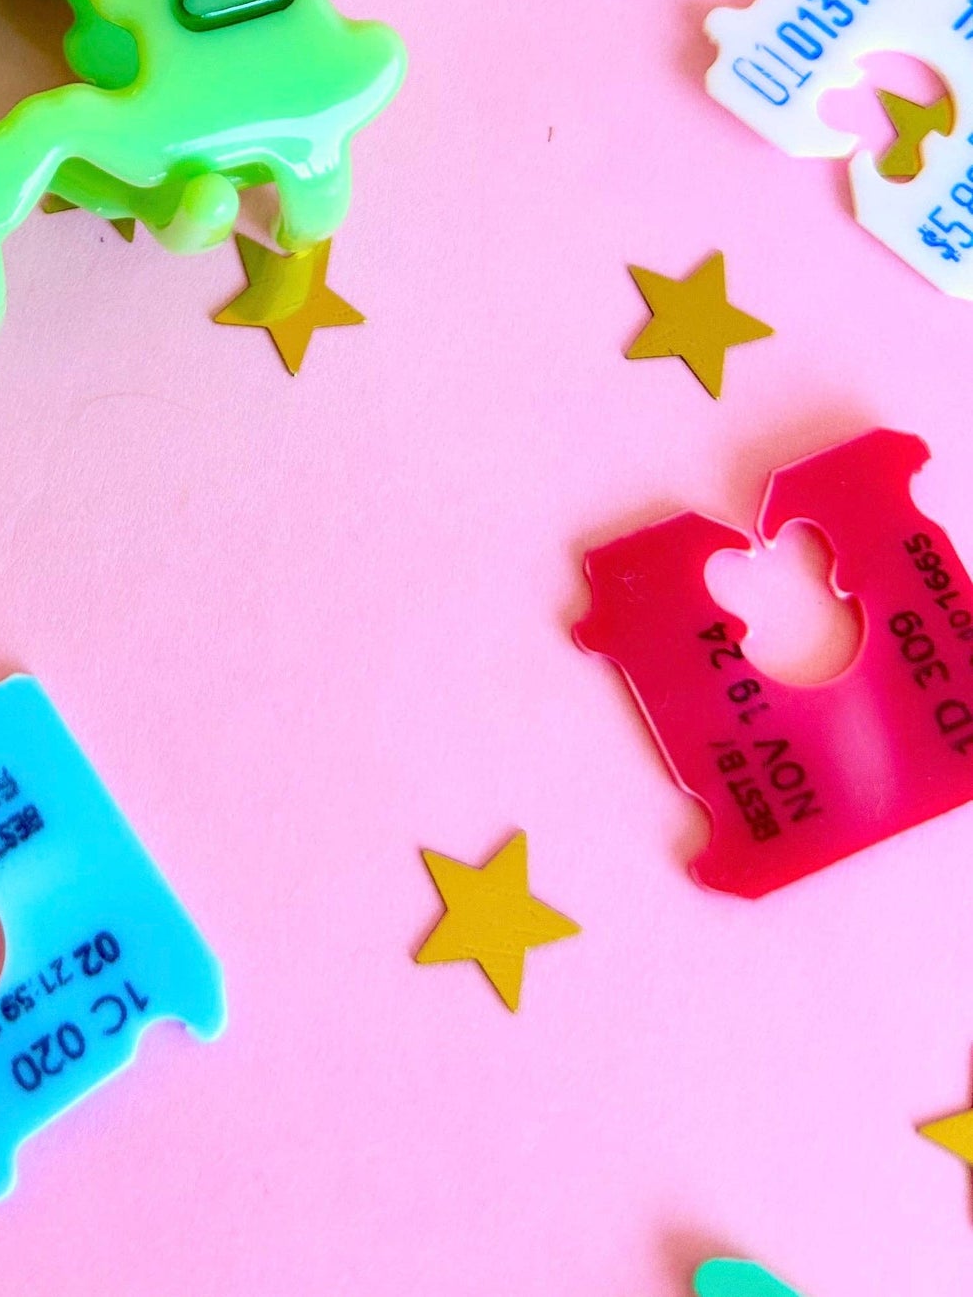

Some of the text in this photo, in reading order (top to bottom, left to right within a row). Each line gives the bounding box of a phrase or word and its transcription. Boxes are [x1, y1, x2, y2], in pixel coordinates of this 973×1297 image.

[888, 609, 951, 691] 309
[696, 620, 824, 824] NOV 19 24
[727, 776, 781, 842] BEST
[72, 931, 121, 978] 02
[11, 979, 150, 1093] 1C 020
